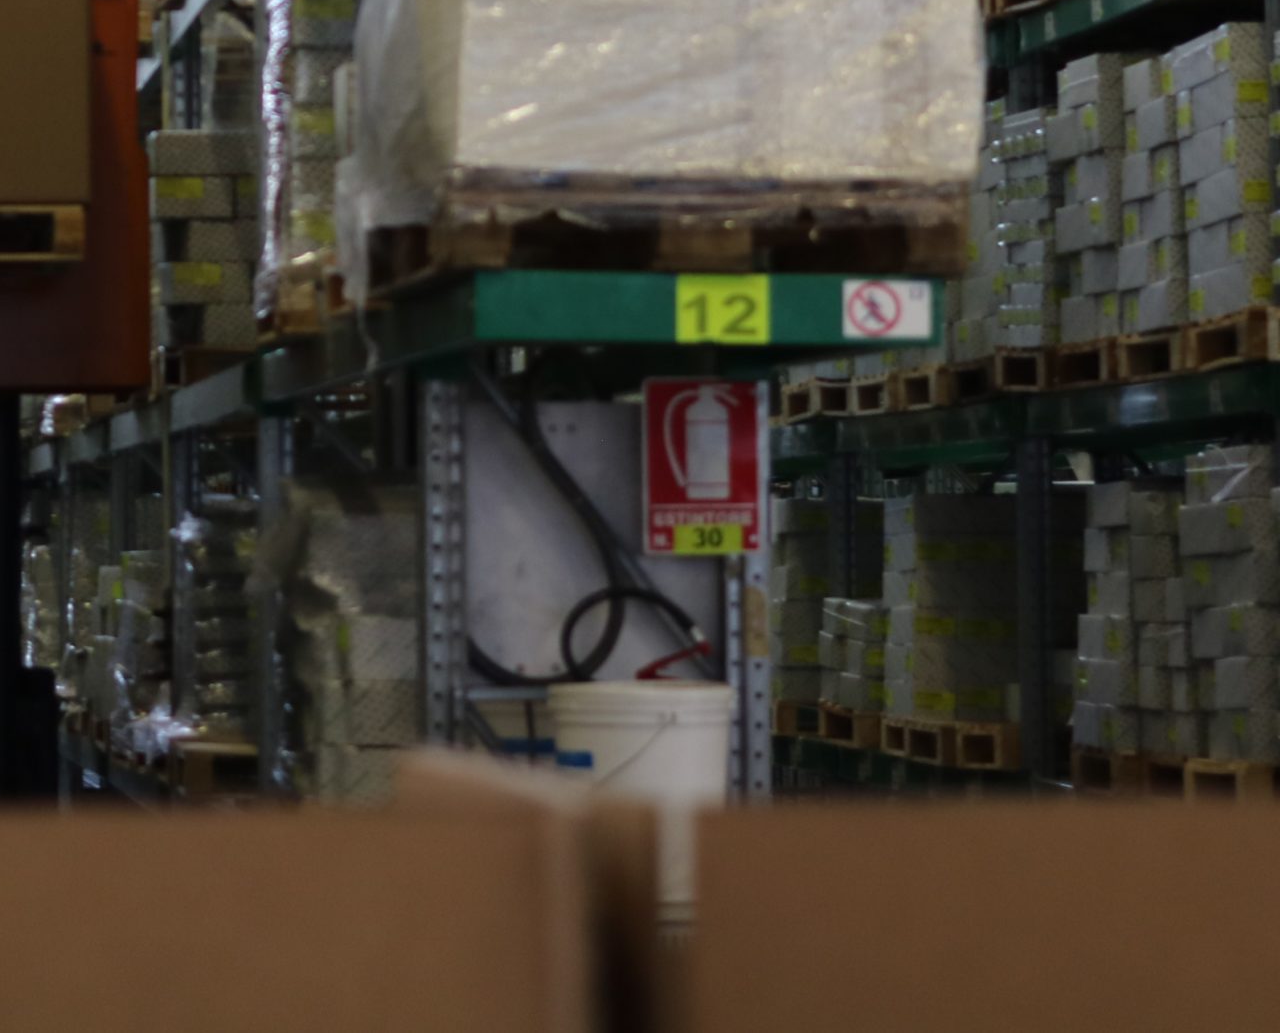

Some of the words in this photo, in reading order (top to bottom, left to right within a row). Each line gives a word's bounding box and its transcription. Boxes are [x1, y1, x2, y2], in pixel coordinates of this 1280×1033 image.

[683, 293, 757, 336] 12
[653, 510, 753, 527] ESTINTORE
[692, 527, 724, 549] 30
